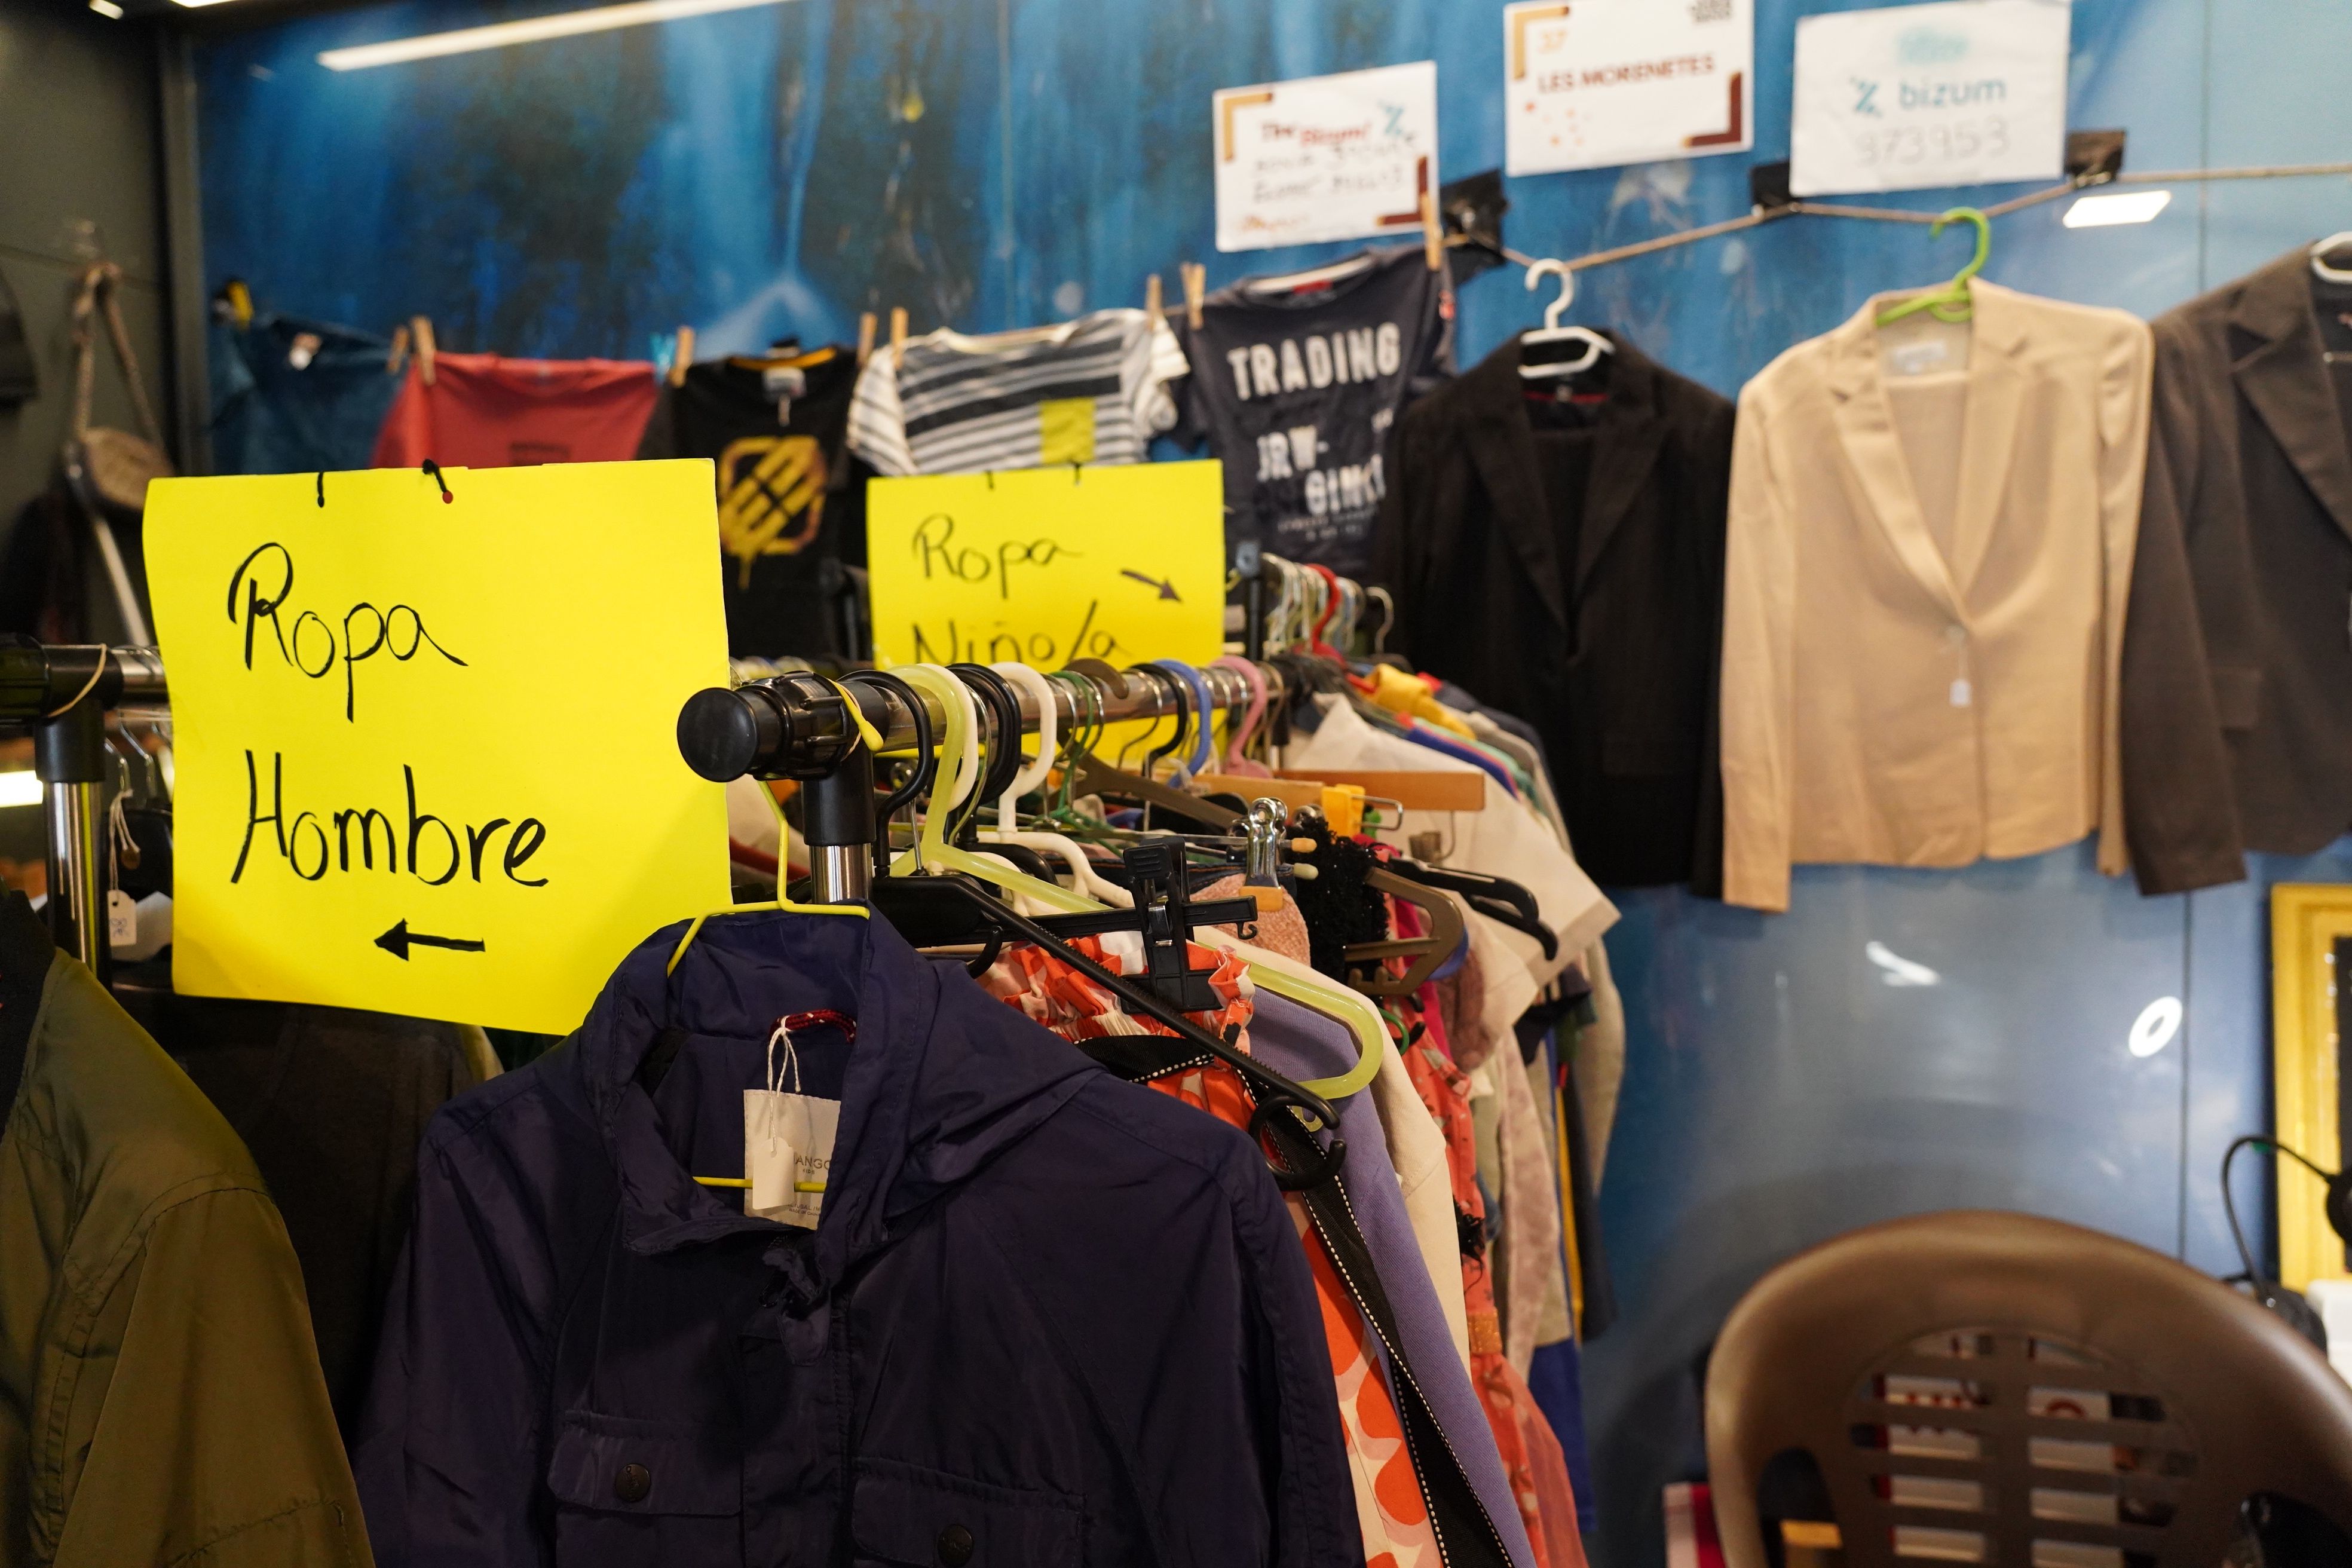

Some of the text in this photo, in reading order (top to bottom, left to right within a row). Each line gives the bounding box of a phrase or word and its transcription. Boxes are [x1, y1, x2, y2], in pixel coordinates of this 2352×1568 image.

[1539, 54, 1716, 93] LES MORENETES
[1899, 77, 2007, 110] bizum
[1227, 321, 1400, 401] TRADING
[912, 513, 1083, 600] Ropa
[228, 542, 468, 723] Ropa
[231, 749, 549, 887] Hombre
[794, 1152, 831, 1171] ANGO
